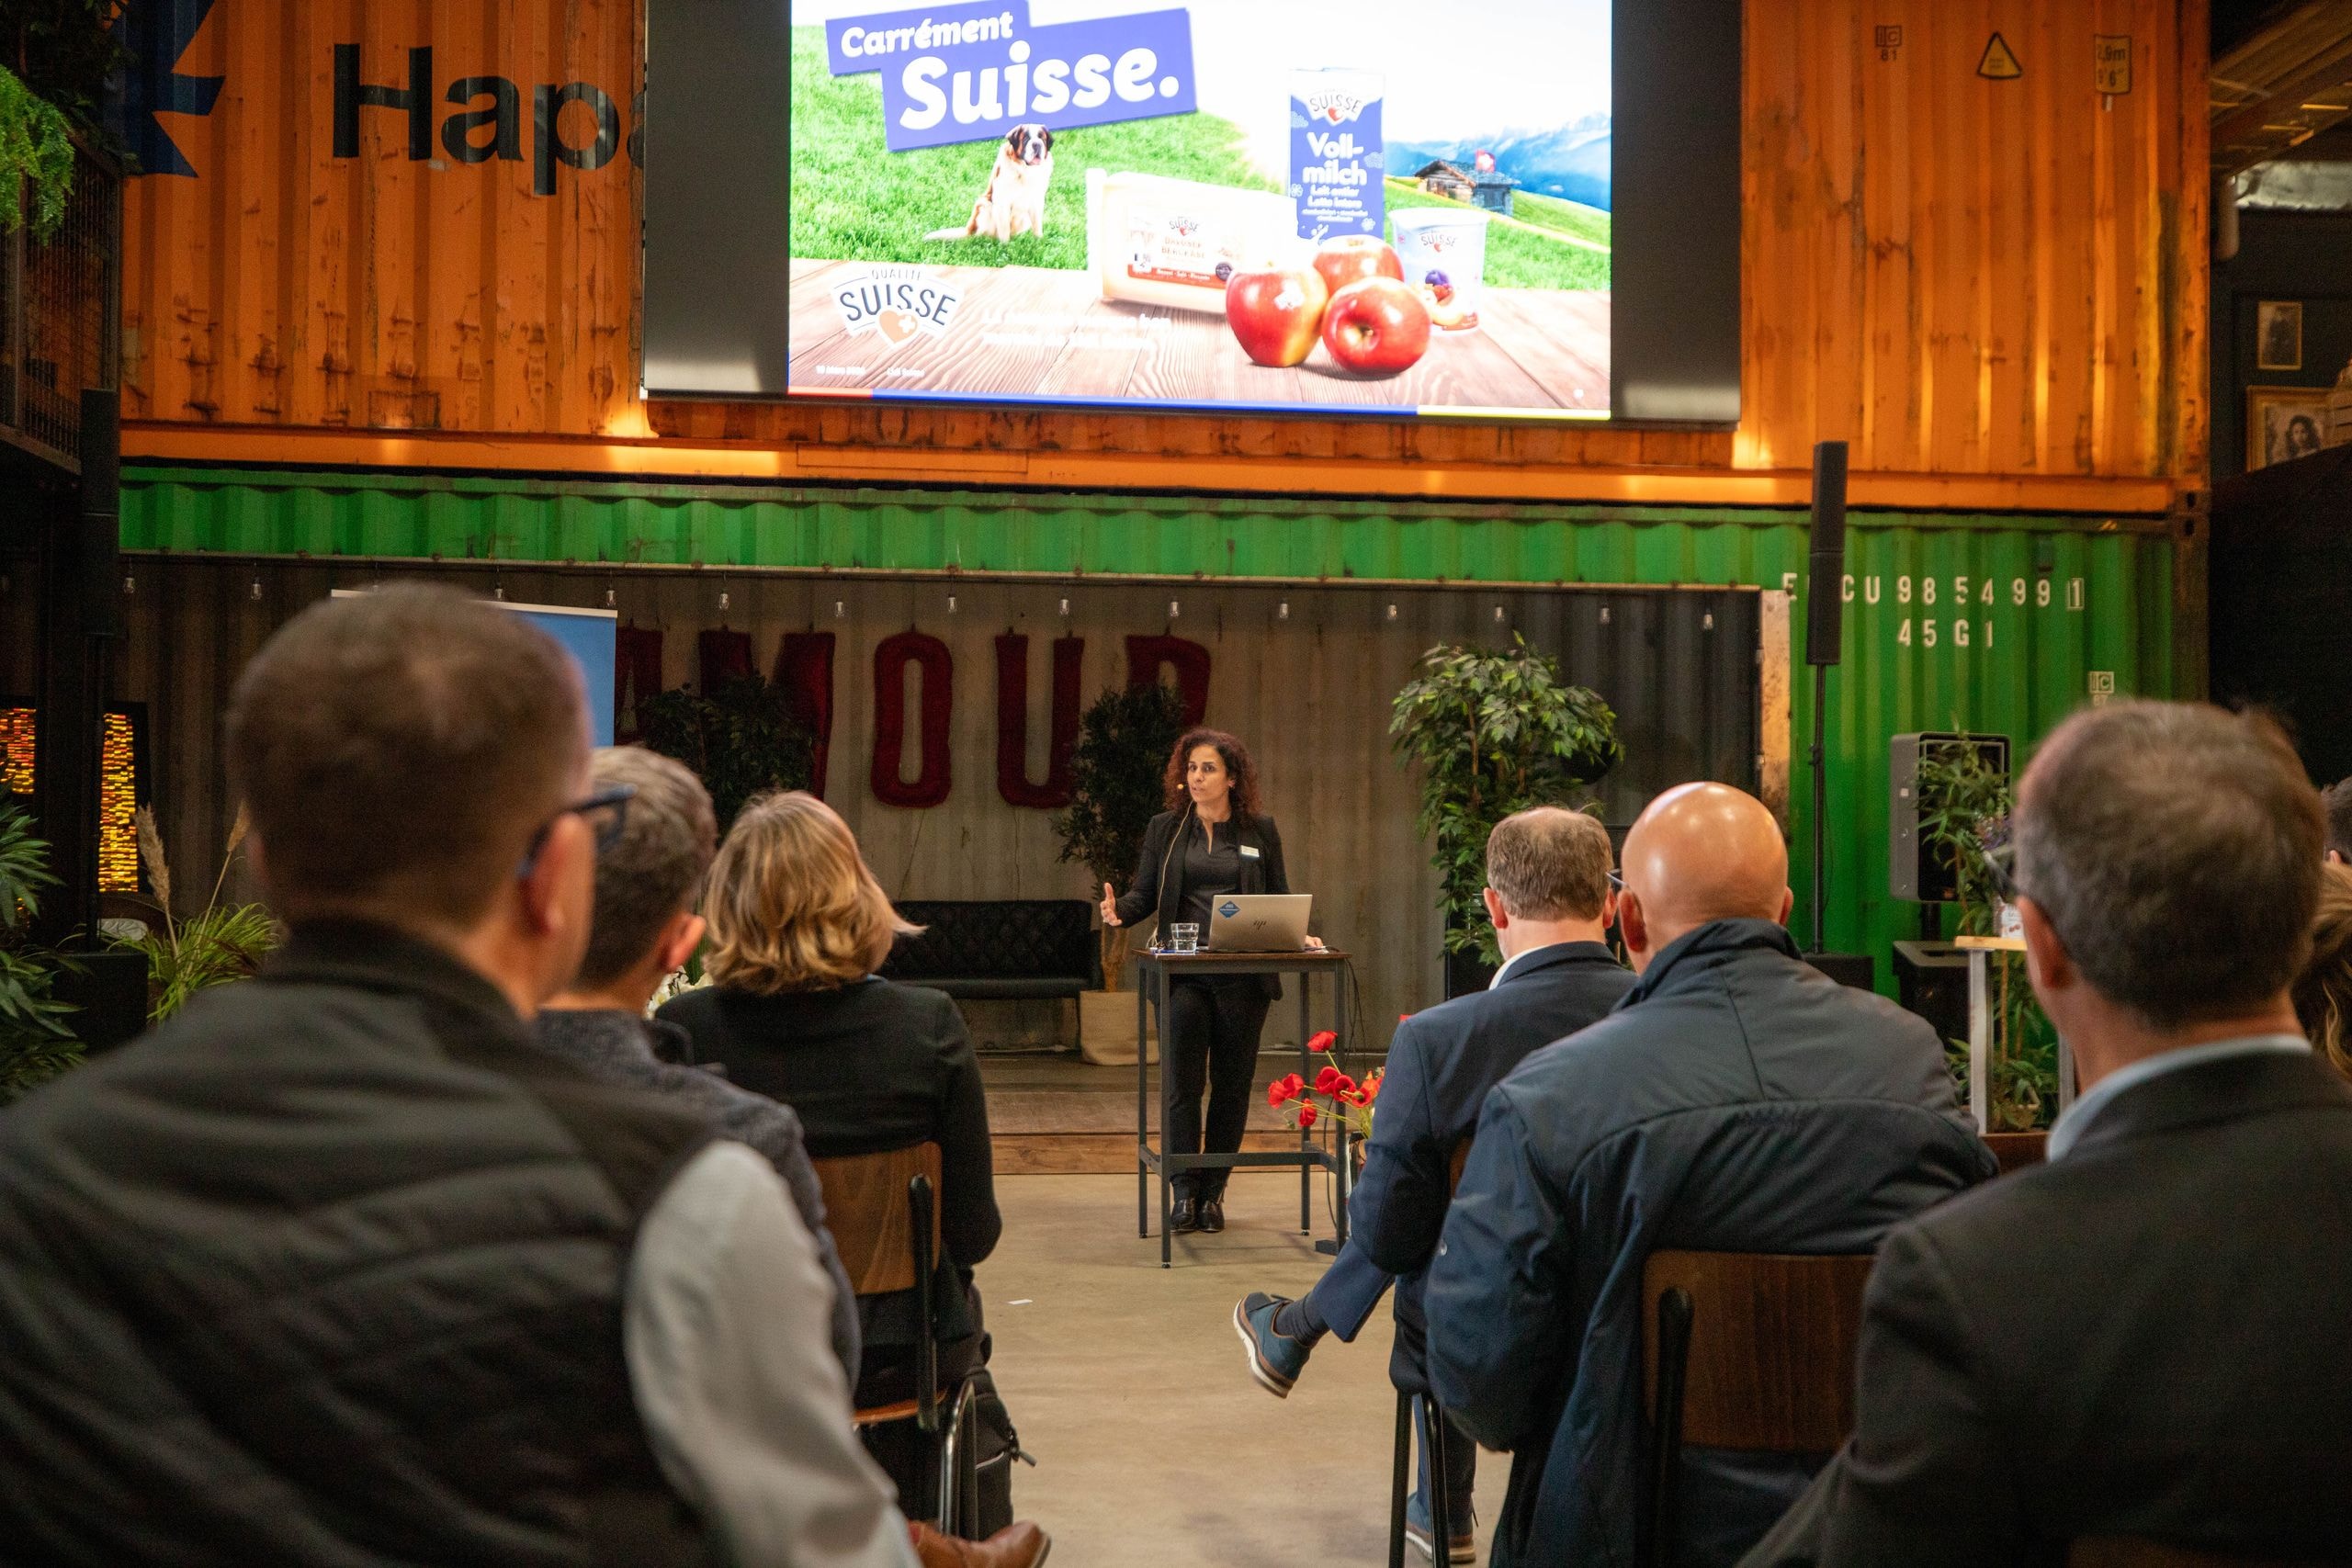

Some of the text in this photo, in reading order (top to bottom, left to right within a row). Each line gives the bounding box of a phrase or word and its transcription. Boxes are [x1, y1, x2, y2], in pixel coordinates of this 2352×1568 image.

[841, 11, 1014, 58] Carrément
[899, 40, 1180, 130] Suisse.
[1309, 94, 1363, 113] SUISSE
[1306, 132, 1364, 159] Voll-
[1303, 159, 1367, 185] milch
[840, 284, 957, 326] SUISSE
[1782, 572, 1881, 604] ECU
